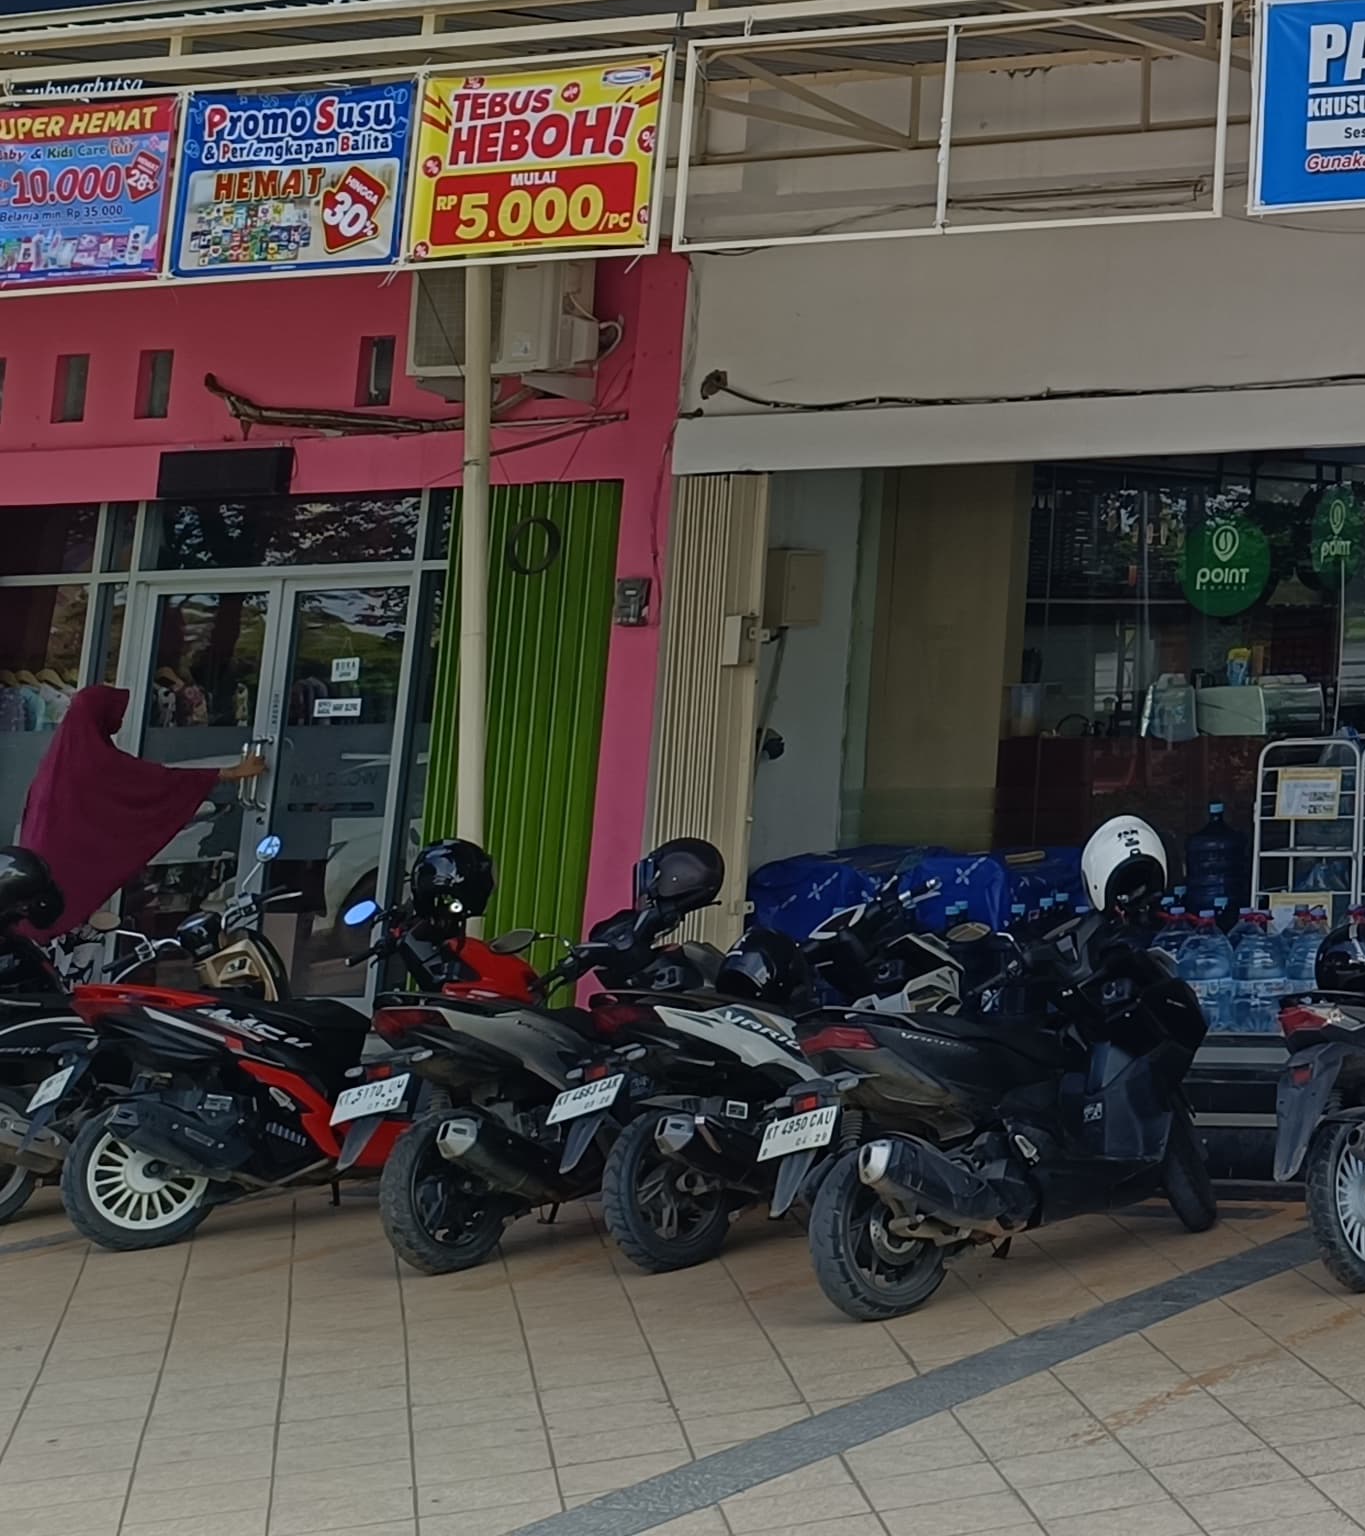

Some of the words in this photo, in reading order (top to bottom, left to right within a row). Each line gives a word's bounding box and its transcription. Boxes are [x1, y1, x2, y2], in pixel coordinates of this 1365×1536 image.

[205, 106, 310, 140] Promo
[316, 98, 393, 131] Susu
[453, 88, 552, 122] TEBUS
[0, 114, 65, 141] UPER
[68, 105, 158, 136] HEMAT
[449, 105, 636, 165] HEBOH!
[47, 145, 73, 159] Kids
[77, 144, 106, 158] Care
[204, 144, 216, 161] &
[221, 138, 336, 162] Perlengkapan
[339, 133, 390, 154] Balita
[12, 163, 122, 205] 10.000
[213, 167, 326, 202] HEMAT
[345, 175, 380, 206] HINGGA
[510, 170, 557, 187] MULAI
[324, 191, 376, 238] 30%
[436, 195, 457, 211] RP
[455, 184, 604, 239] 5.000
[599, 212, 631, 231] /PC
[809, 1109, 833, 1128] CAU
